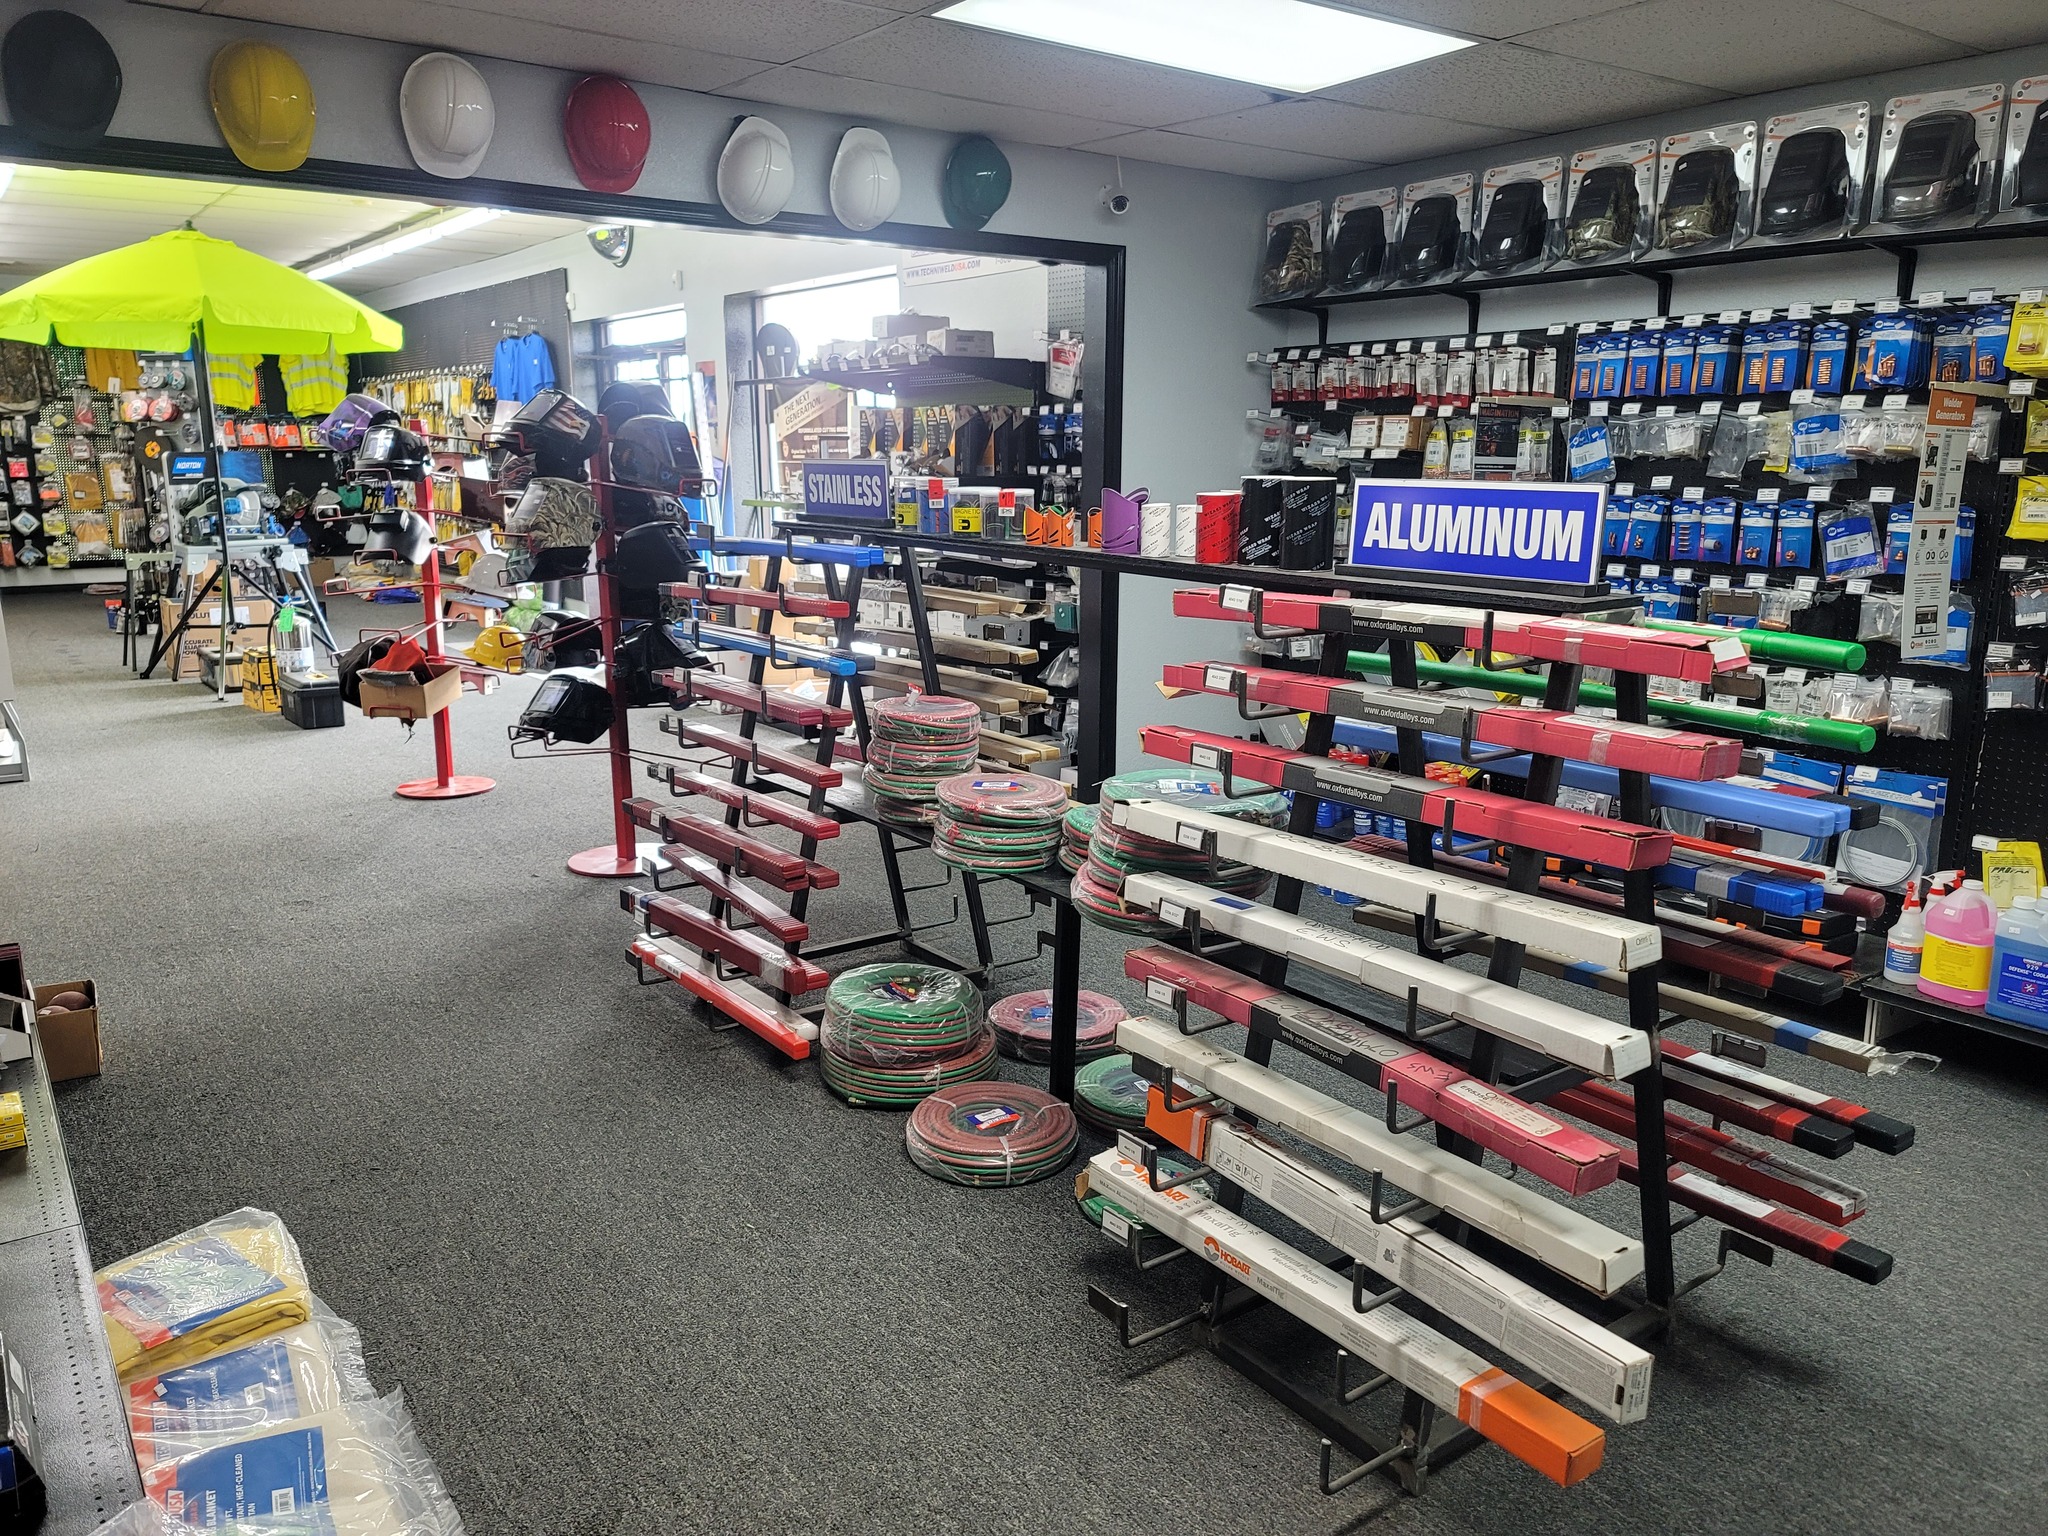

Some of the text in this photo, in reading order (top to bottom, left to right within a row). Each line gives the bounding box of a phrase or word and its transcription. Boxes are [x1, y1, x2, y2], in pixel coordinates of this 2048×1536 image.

[906, 260, 981, 278] WWW.TECHNIWELDUSA.COM
[795, 391, 811, 409] NEXT
[1943, 397, 1962, 409] Welder
[1480, 407, 1520, 418] IMAGINATION
[1935, 409, 1965, 421] Generators
[808, 473, 883, 507] STAINLESS
[1362, 503, 1585, 562] ALUMINUM
[1353, 619, 1424, 634] www.oxfordalloys.com
[1363, 705, 1434, 725] www.oxfordalloys.com
[1316, 781, 1383, 802] www.oxfordalloys.com
[1281, 1029, 1344, 1065] www.oxfordalloys.com
[1195, 1208, 1242, 1238] MaxalTig
[1220, 1249, 1251, 1277] HOBART
[235, 1454, 244, 1501] HEAT-CLEANED
[206, 1489, 217, 1526] BLANKET
[247, 1503, 256, 1516] TAN
